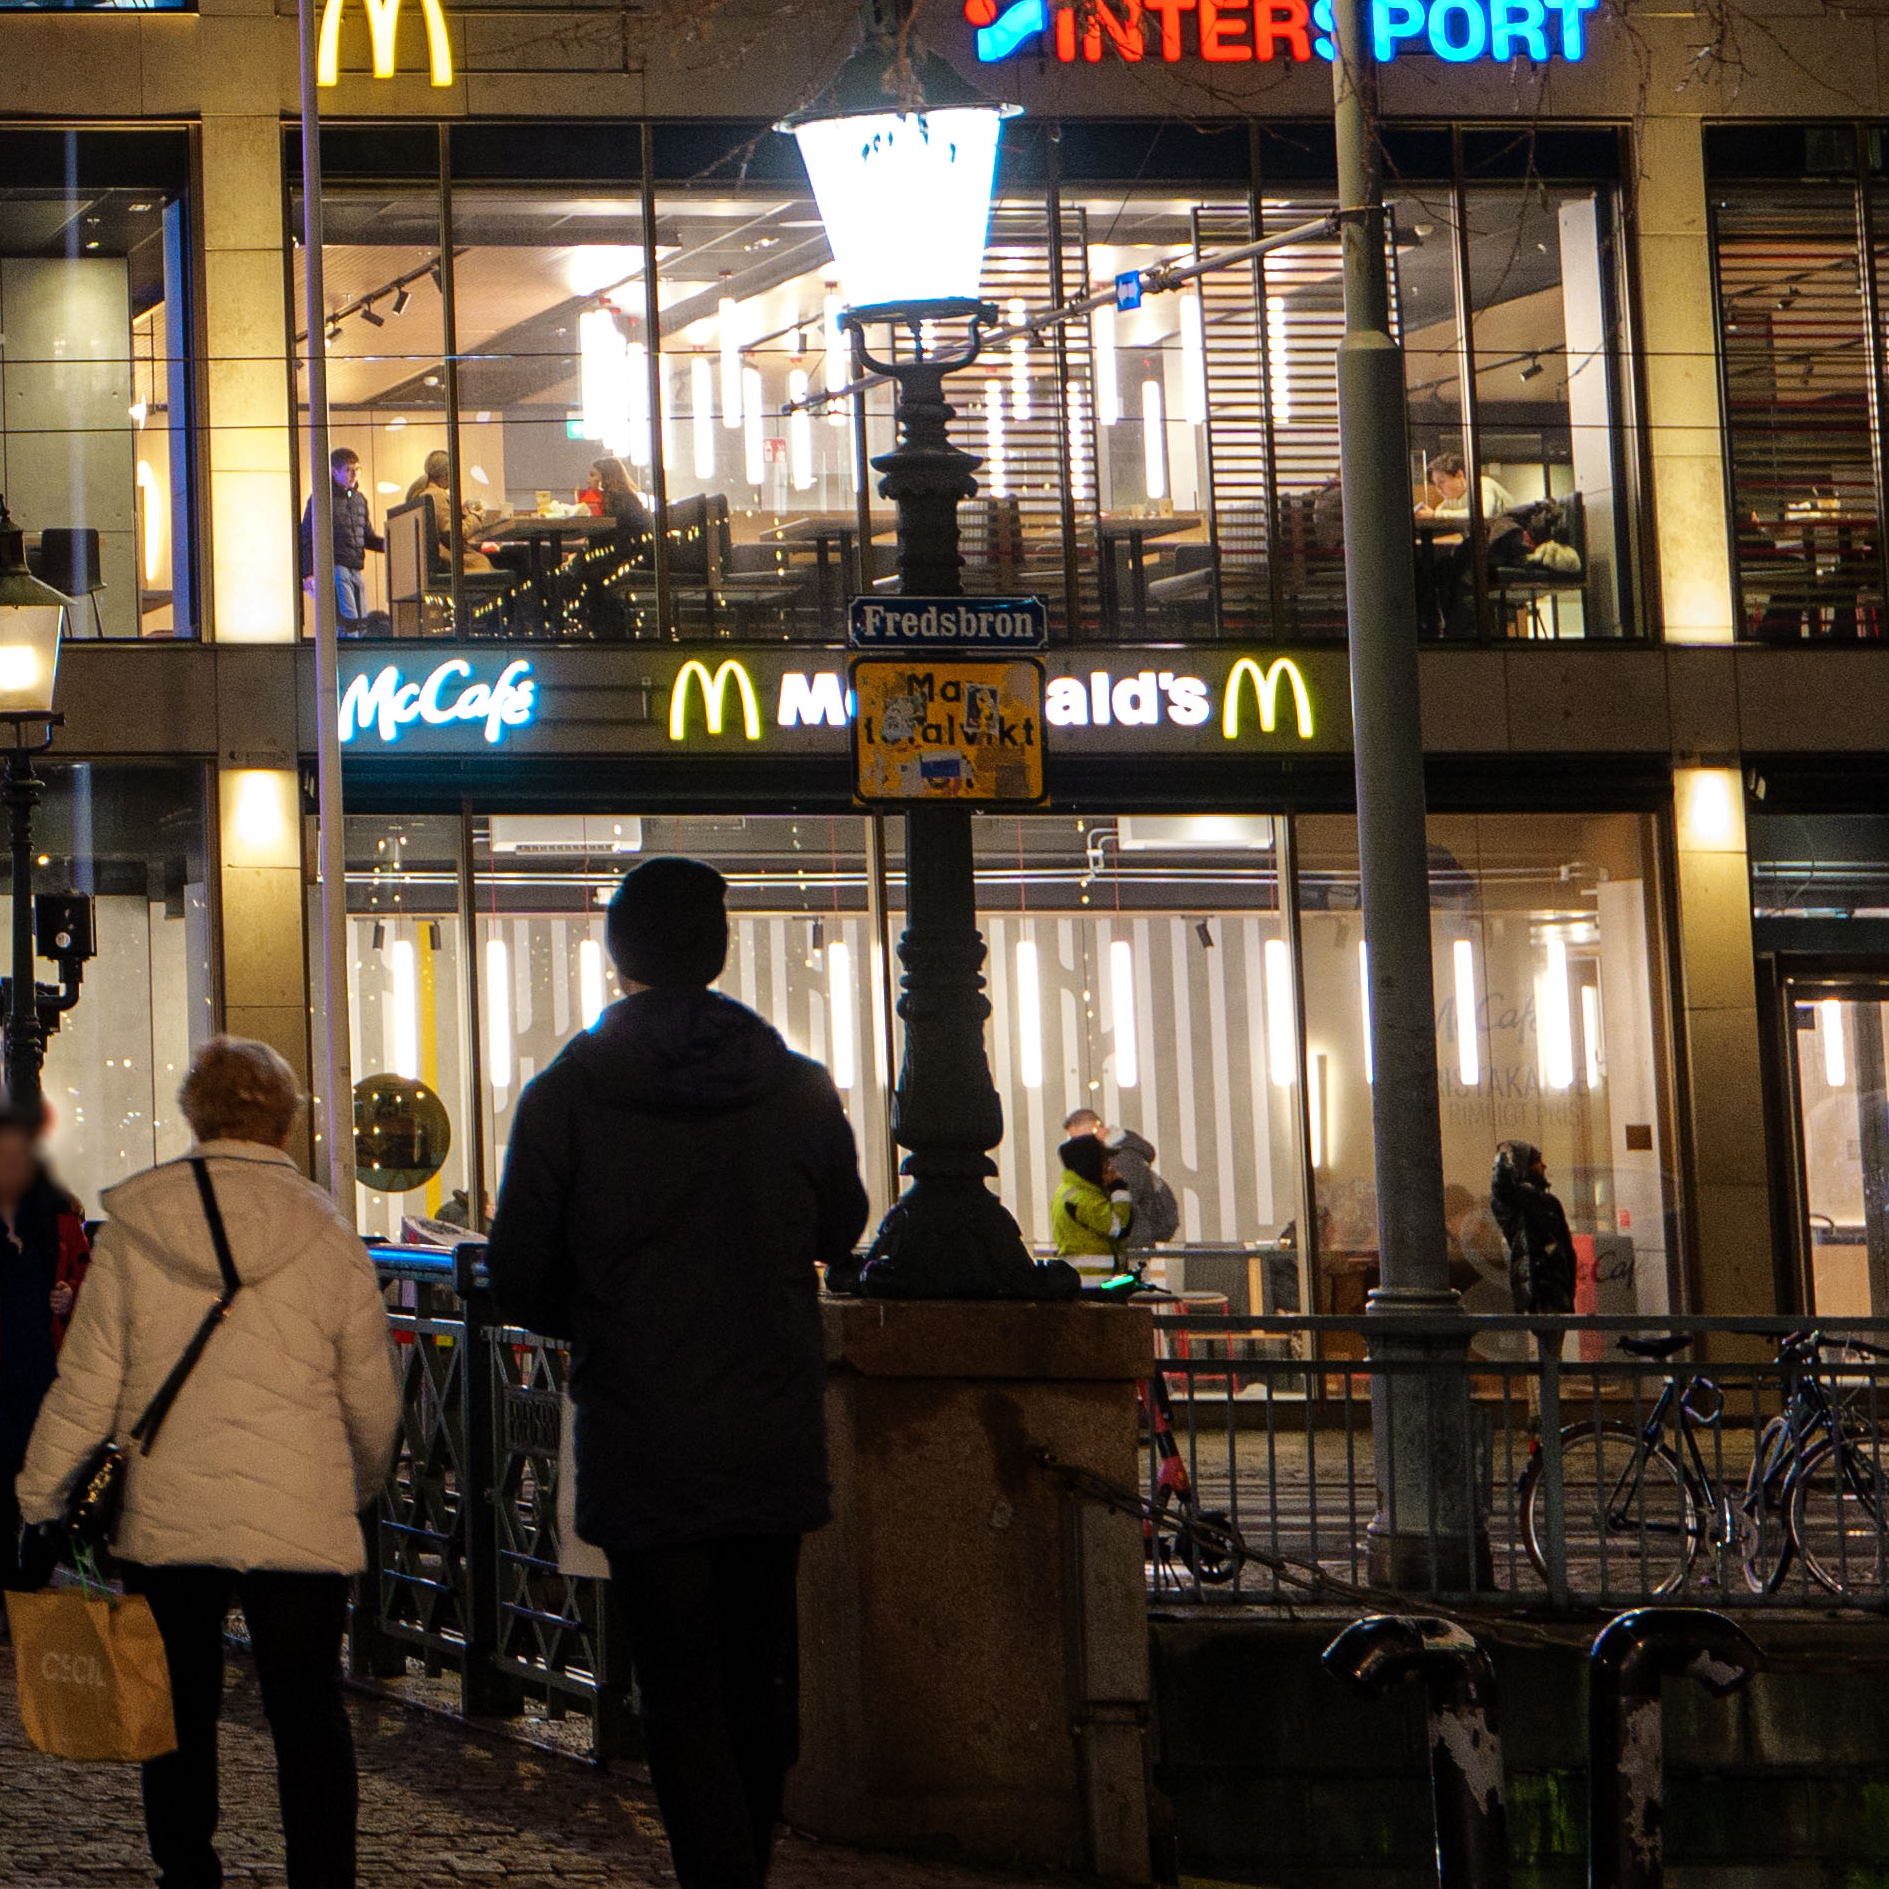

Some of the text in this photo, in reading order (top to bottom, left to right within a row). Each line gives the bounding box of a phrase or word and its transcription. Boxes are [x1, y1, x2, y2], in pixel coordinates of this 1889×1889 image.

[862, 605, 1035, 639] Fredsbron
[777, 672, 1213, 726] Mald's
[906, 673, 964, 704] Ma
